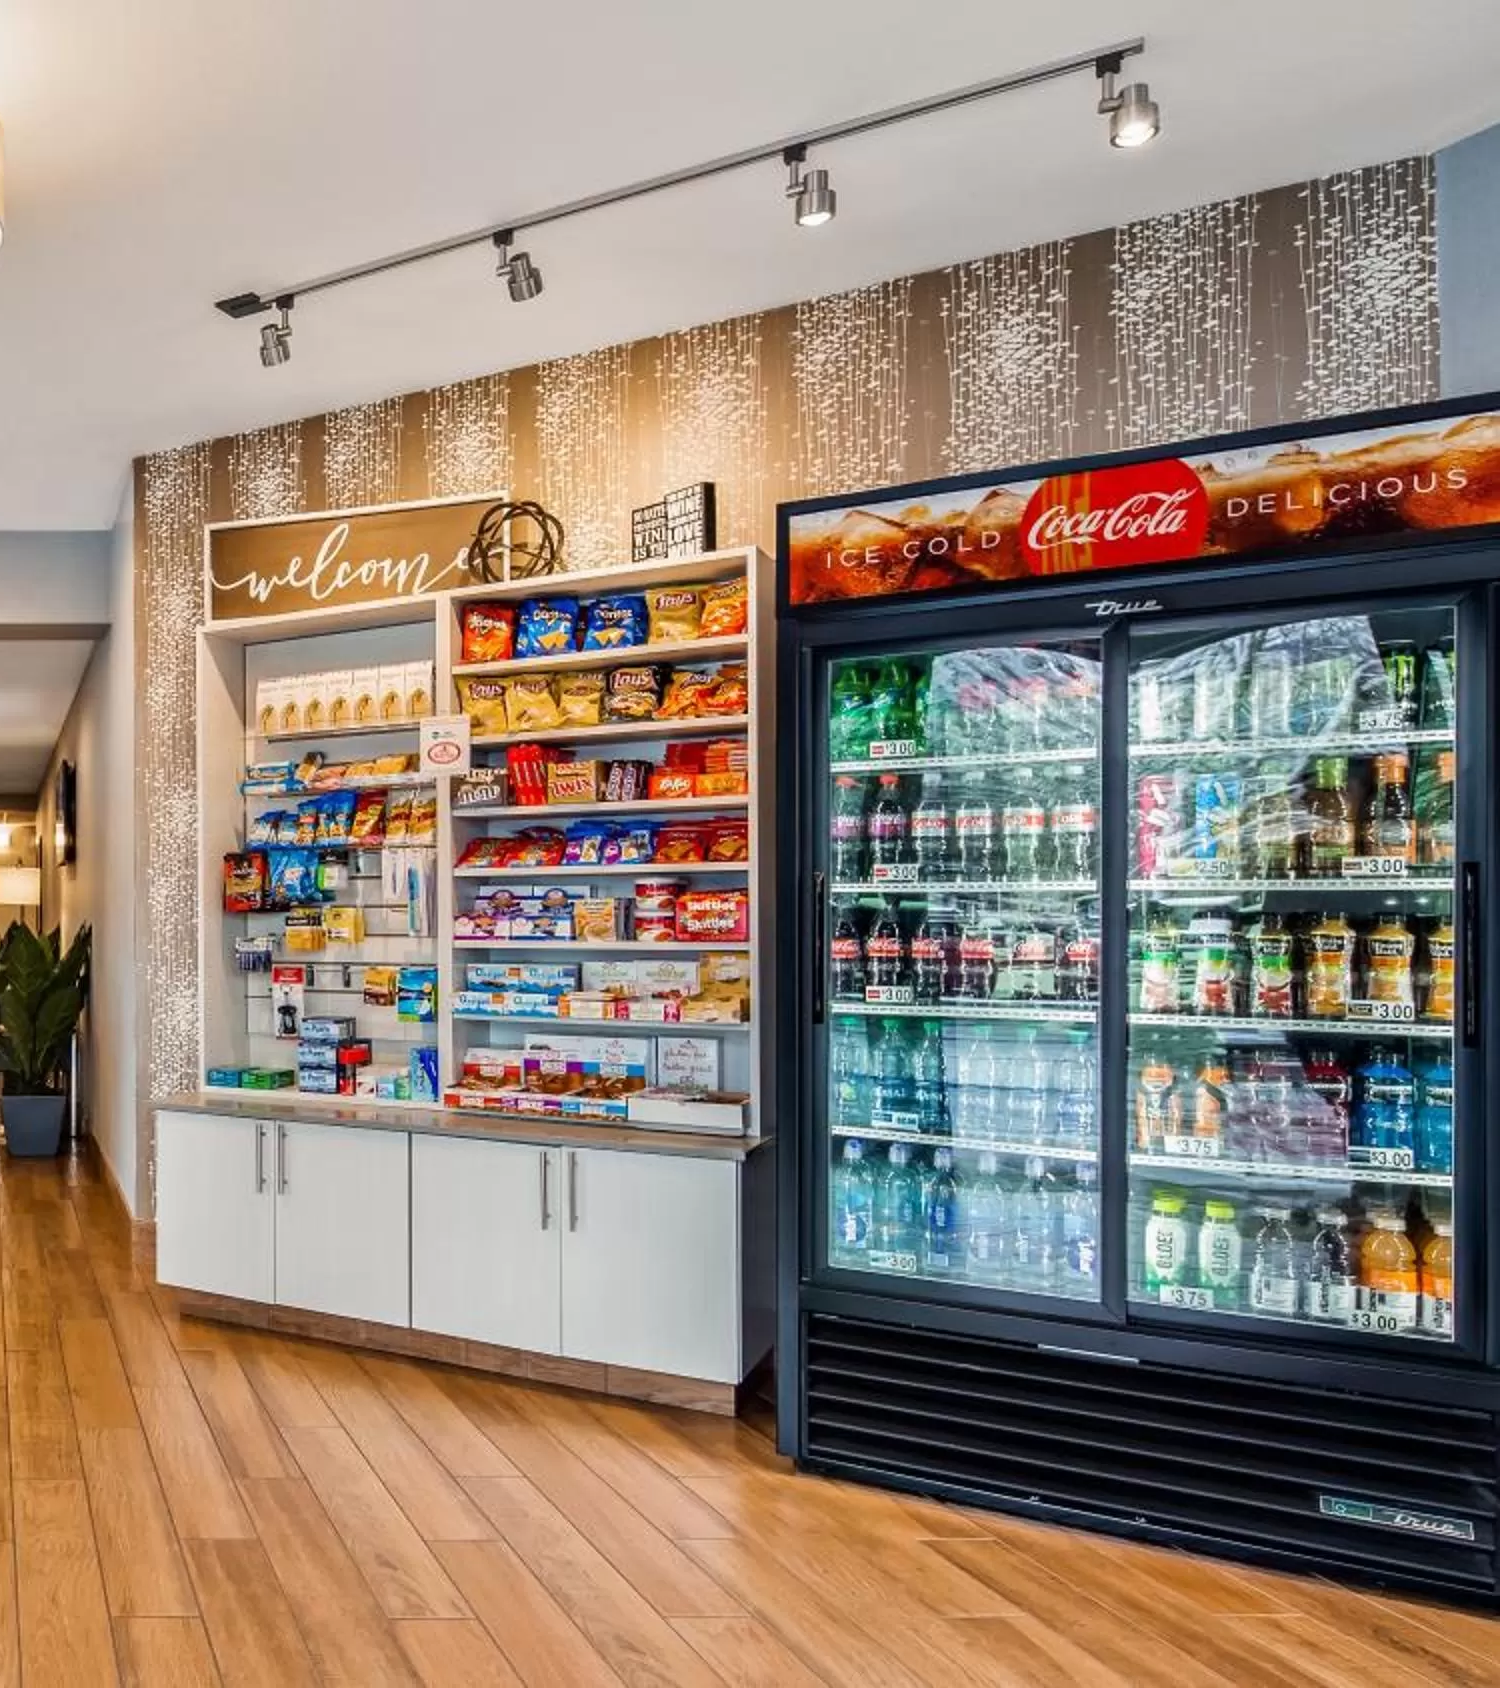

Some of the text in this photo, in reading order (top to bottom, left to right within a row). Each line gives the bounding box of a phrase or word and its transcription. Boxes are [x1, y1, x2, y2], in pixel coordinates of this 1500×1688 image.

[1228, 469, 1468, 517] DELICIOUS
[1028, 487, 1197, 549] Coca-Cola
[211, 523, 476, 603] welcome
[826, 531, 1001, 569] ICE COLD
[1085, 600, 1164, 616] True
[1374, 1004, 1413, 1018] $3.00
[1352, 1313, 1397, 1330] $3.00
